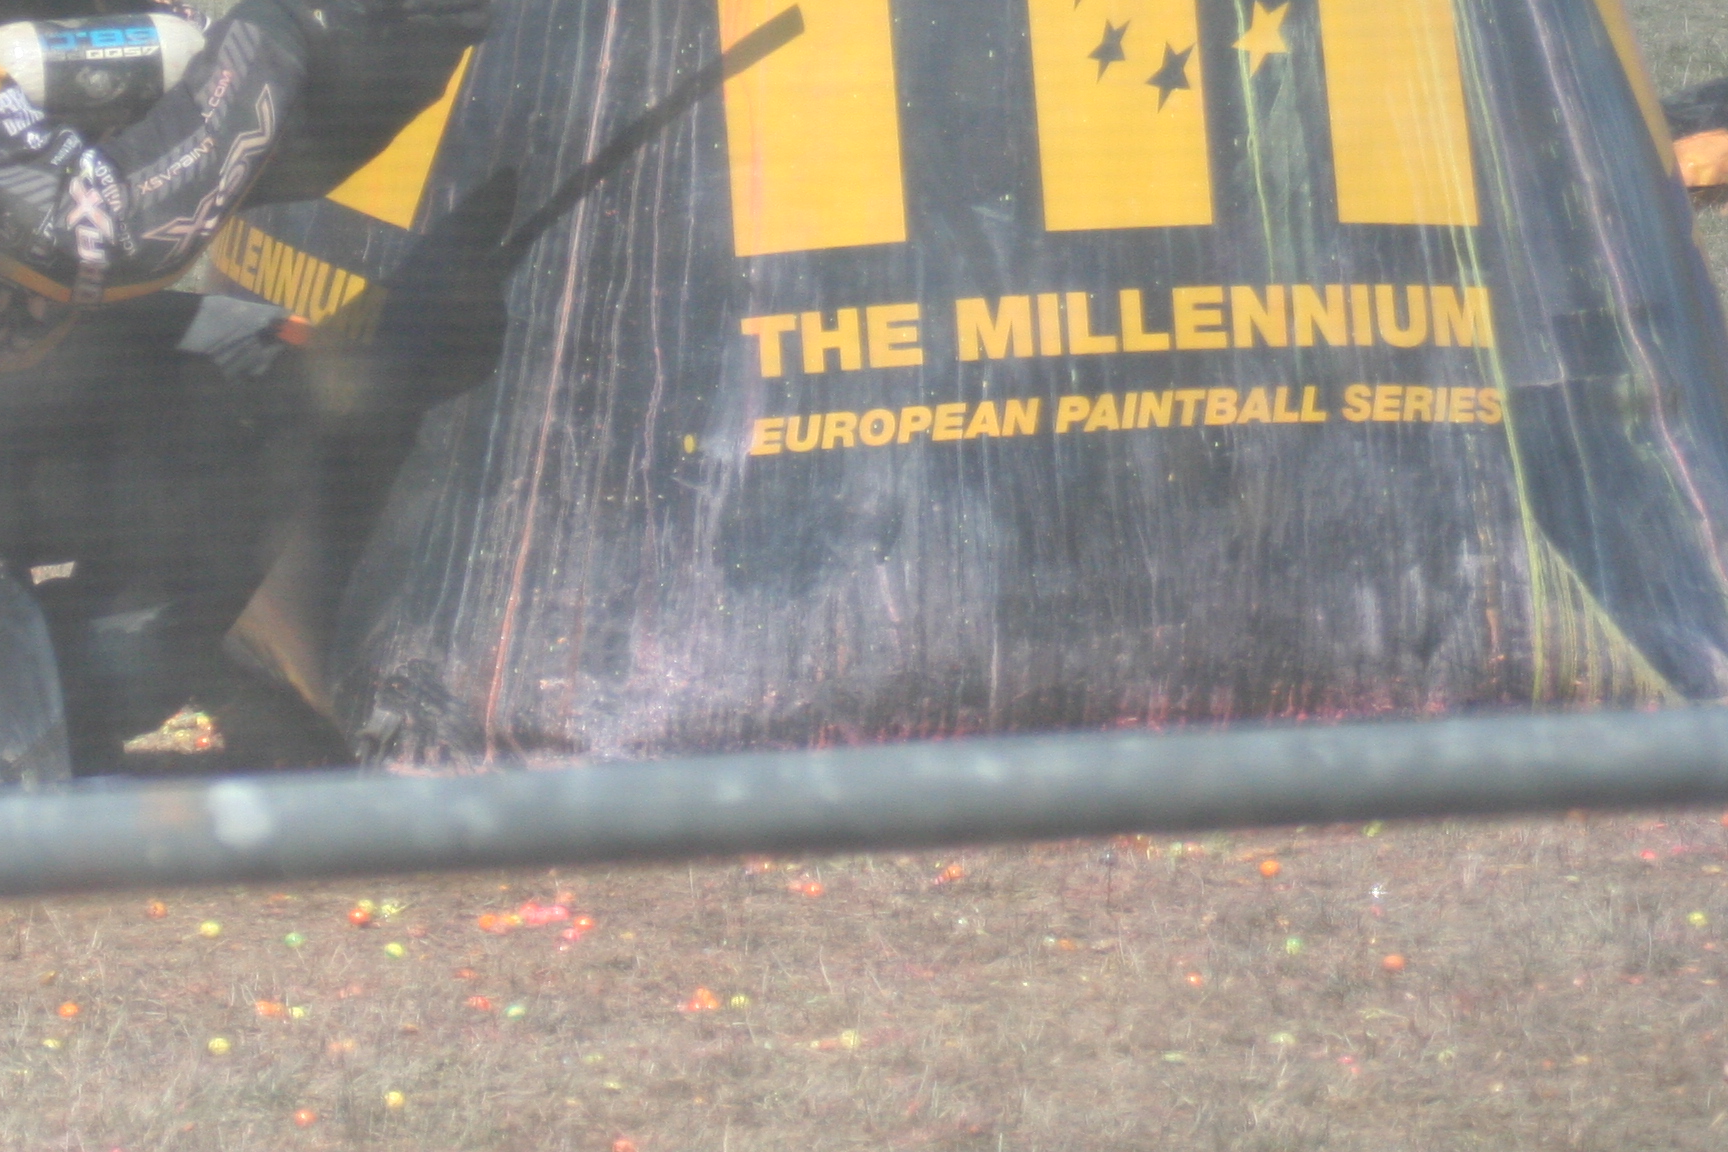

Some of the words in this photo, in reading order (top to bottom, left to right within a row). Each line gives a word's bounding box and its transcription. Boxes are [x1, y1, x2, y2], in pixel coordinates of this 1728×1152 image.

[741, 302, 924, 378] THE
[955, 284, 1497, 361] MILLENNIUM
[749, 396, 1040, 456] EUROPEAN
[1055, 384, 1329, 434] PAINTBALL
[1343, 383, 1506, 425] SERIES
